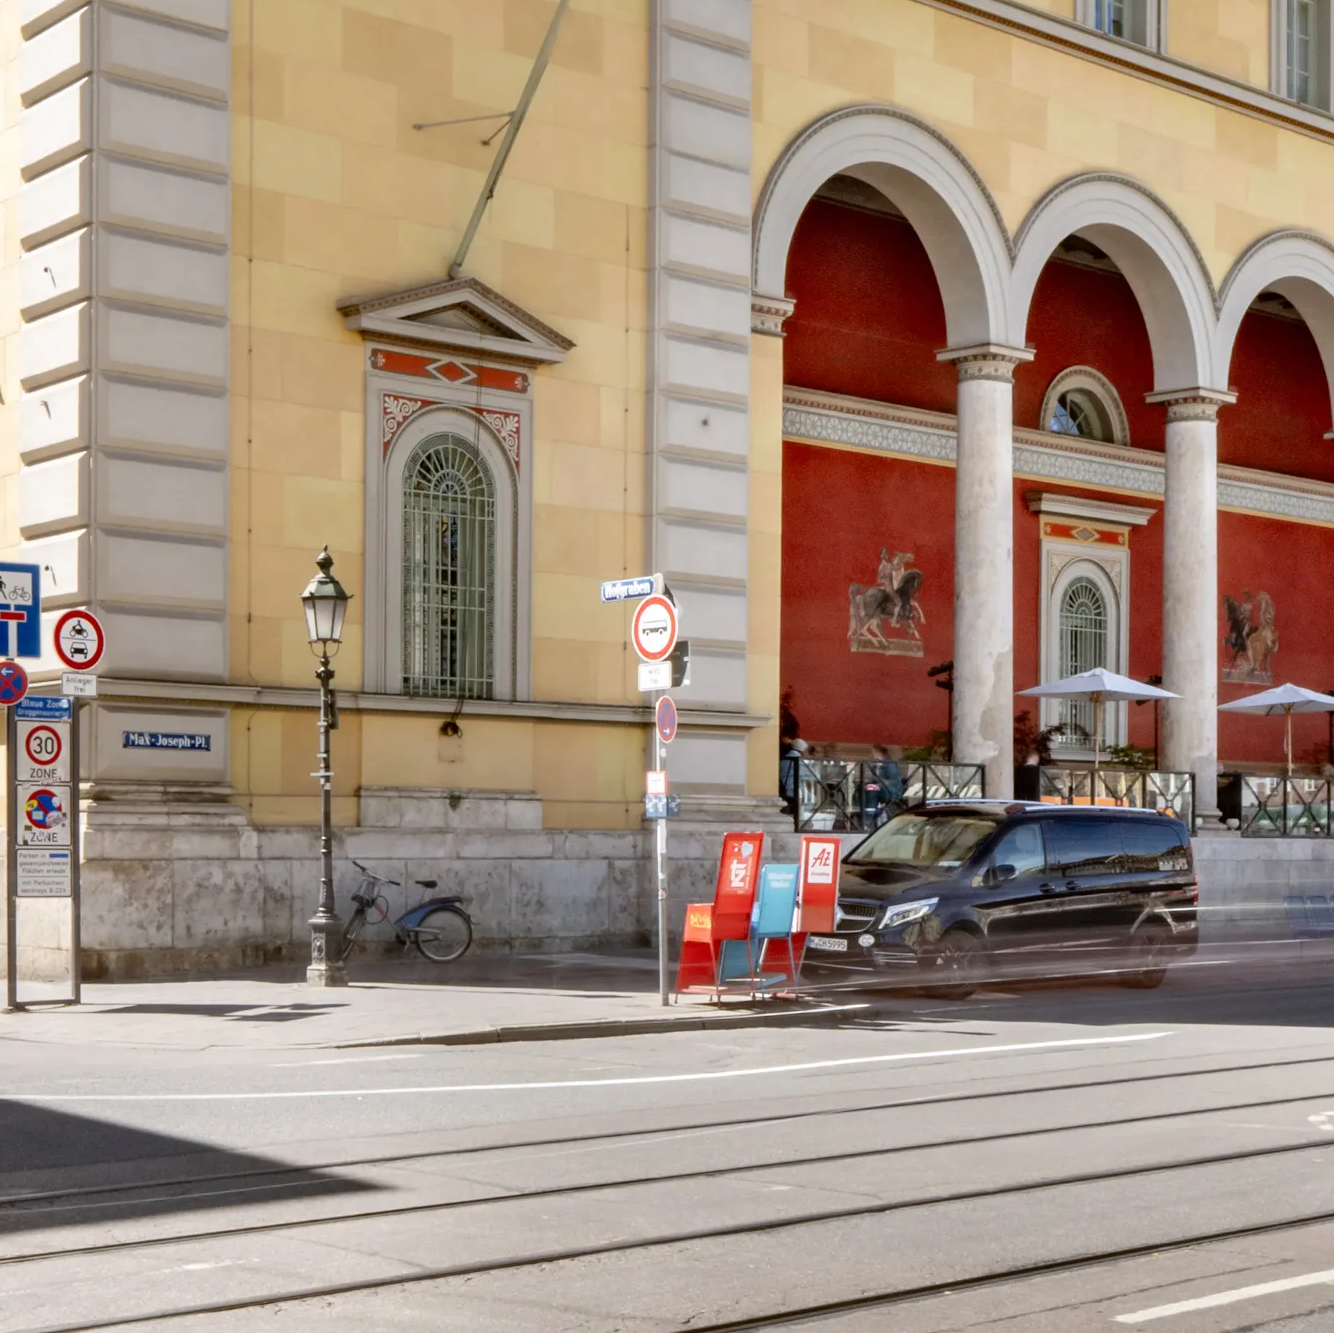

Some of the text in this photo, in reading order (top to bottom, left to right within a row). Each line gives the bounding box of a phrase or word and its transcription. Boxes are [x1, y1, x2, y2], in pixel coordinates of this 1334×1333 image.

[604, 581, 651, 599] Hofgraben
[21, 699, 43, 708] Blaue
[33, 736, 55, 755] 30
[29, 768, 58, 779] ZONE
